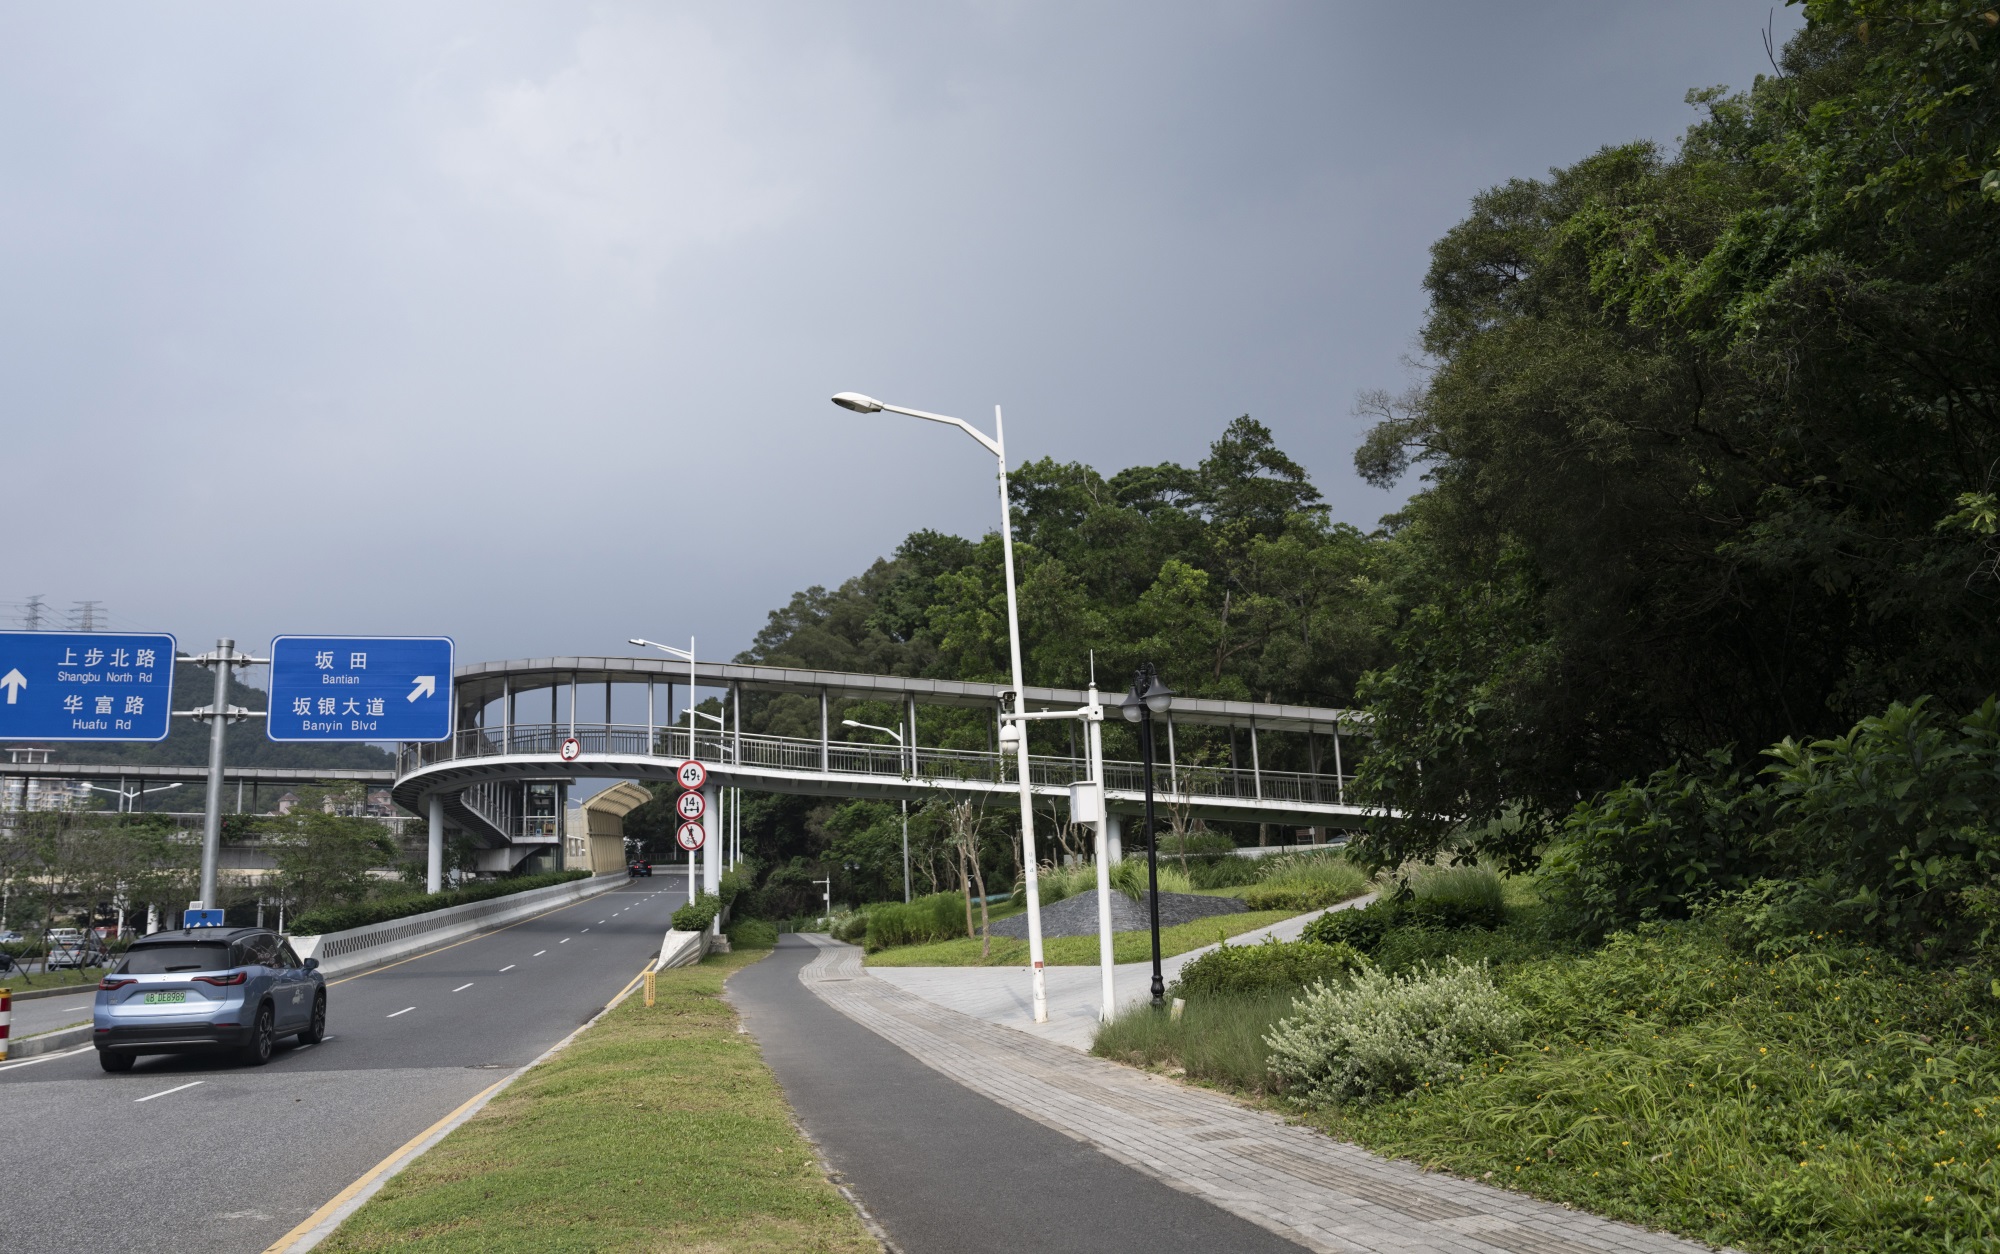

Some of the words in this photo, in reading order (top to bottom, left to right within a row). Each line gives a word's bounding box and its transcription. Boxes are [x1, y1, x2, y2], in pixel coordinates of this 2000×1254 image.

[57, 647, 156, 668] 上步北路
[315, 650, 367, 670] 坂田
[57, 671, 100, 684] Shangbu
[106, 672, 133, 683] North
[138, 672, 153, 683] Rd
[322, 674, 360, 684] Bantian
[63, 694, 145, 715] 华富路
[292, 696, 386, 716] 坂银大道
[72, 719, 108, 730] Huafu
[115, 719, 132, 730] Rd
[302, 720, 343, 733] Banyin
[351, 720, 377, 731] Blvd
[683, 768, 700, 781] 49t
